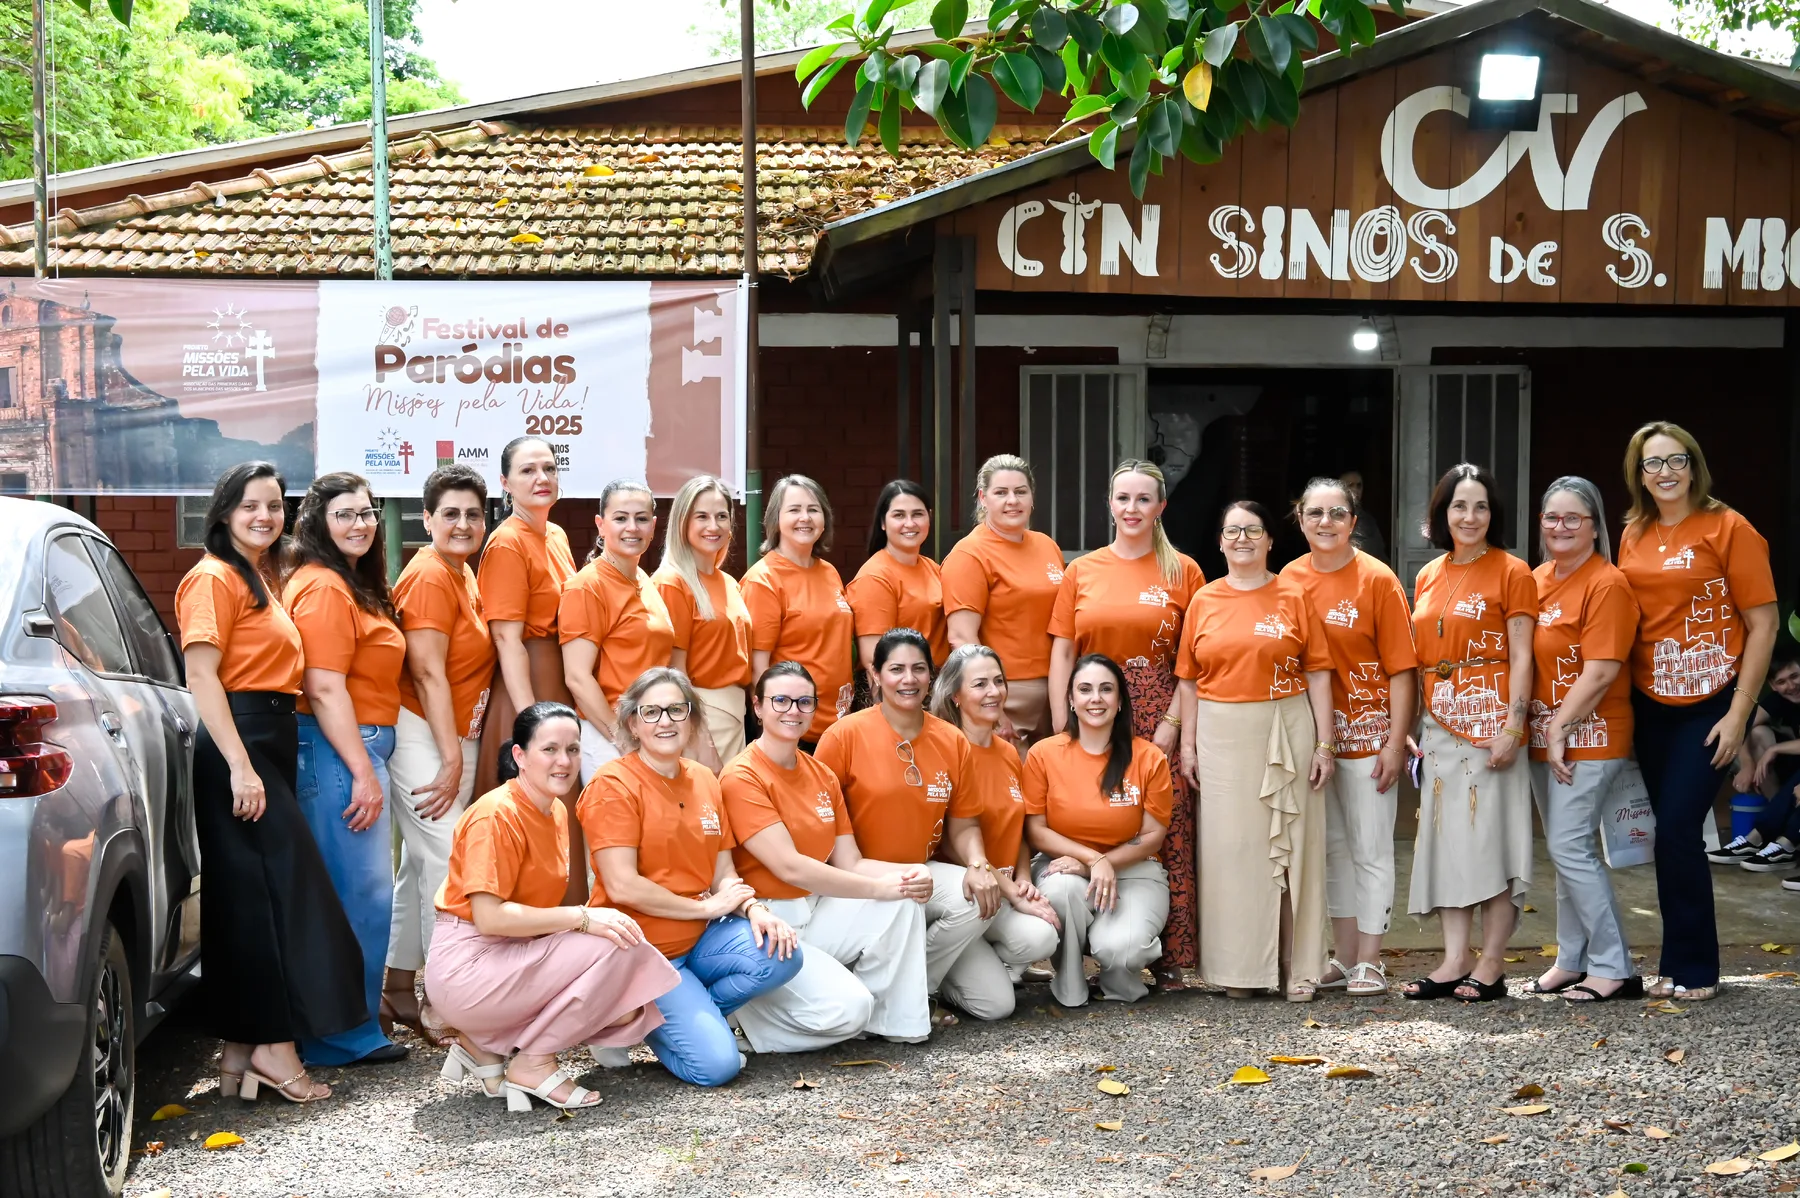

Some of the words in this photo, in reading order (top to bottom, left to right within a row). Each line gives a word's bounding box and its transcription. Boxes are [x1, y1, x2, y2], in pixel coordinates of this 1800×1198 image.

[1208, 204, 1459, 284] SINOS
[1602, 212, 1667, 288] S.
[422, 317, 528, 340] Festival
[536, 317, 569, 339] de
[182, 350, 240, 364] MISSÕES
[374, 342, 577, 385] Paródias
[182, 364, 215, 377] PELA
[218, 365, 249, 377] VIDA
[362, 384, 445, 419] Missões
[455, 379, 507, 428] pela
[517, 374, 590, 415] Vida!
[525, 415, 583, 436] 2025
[458, 448, 488, 458] AMM
[552, 444, 570, 454] nos
